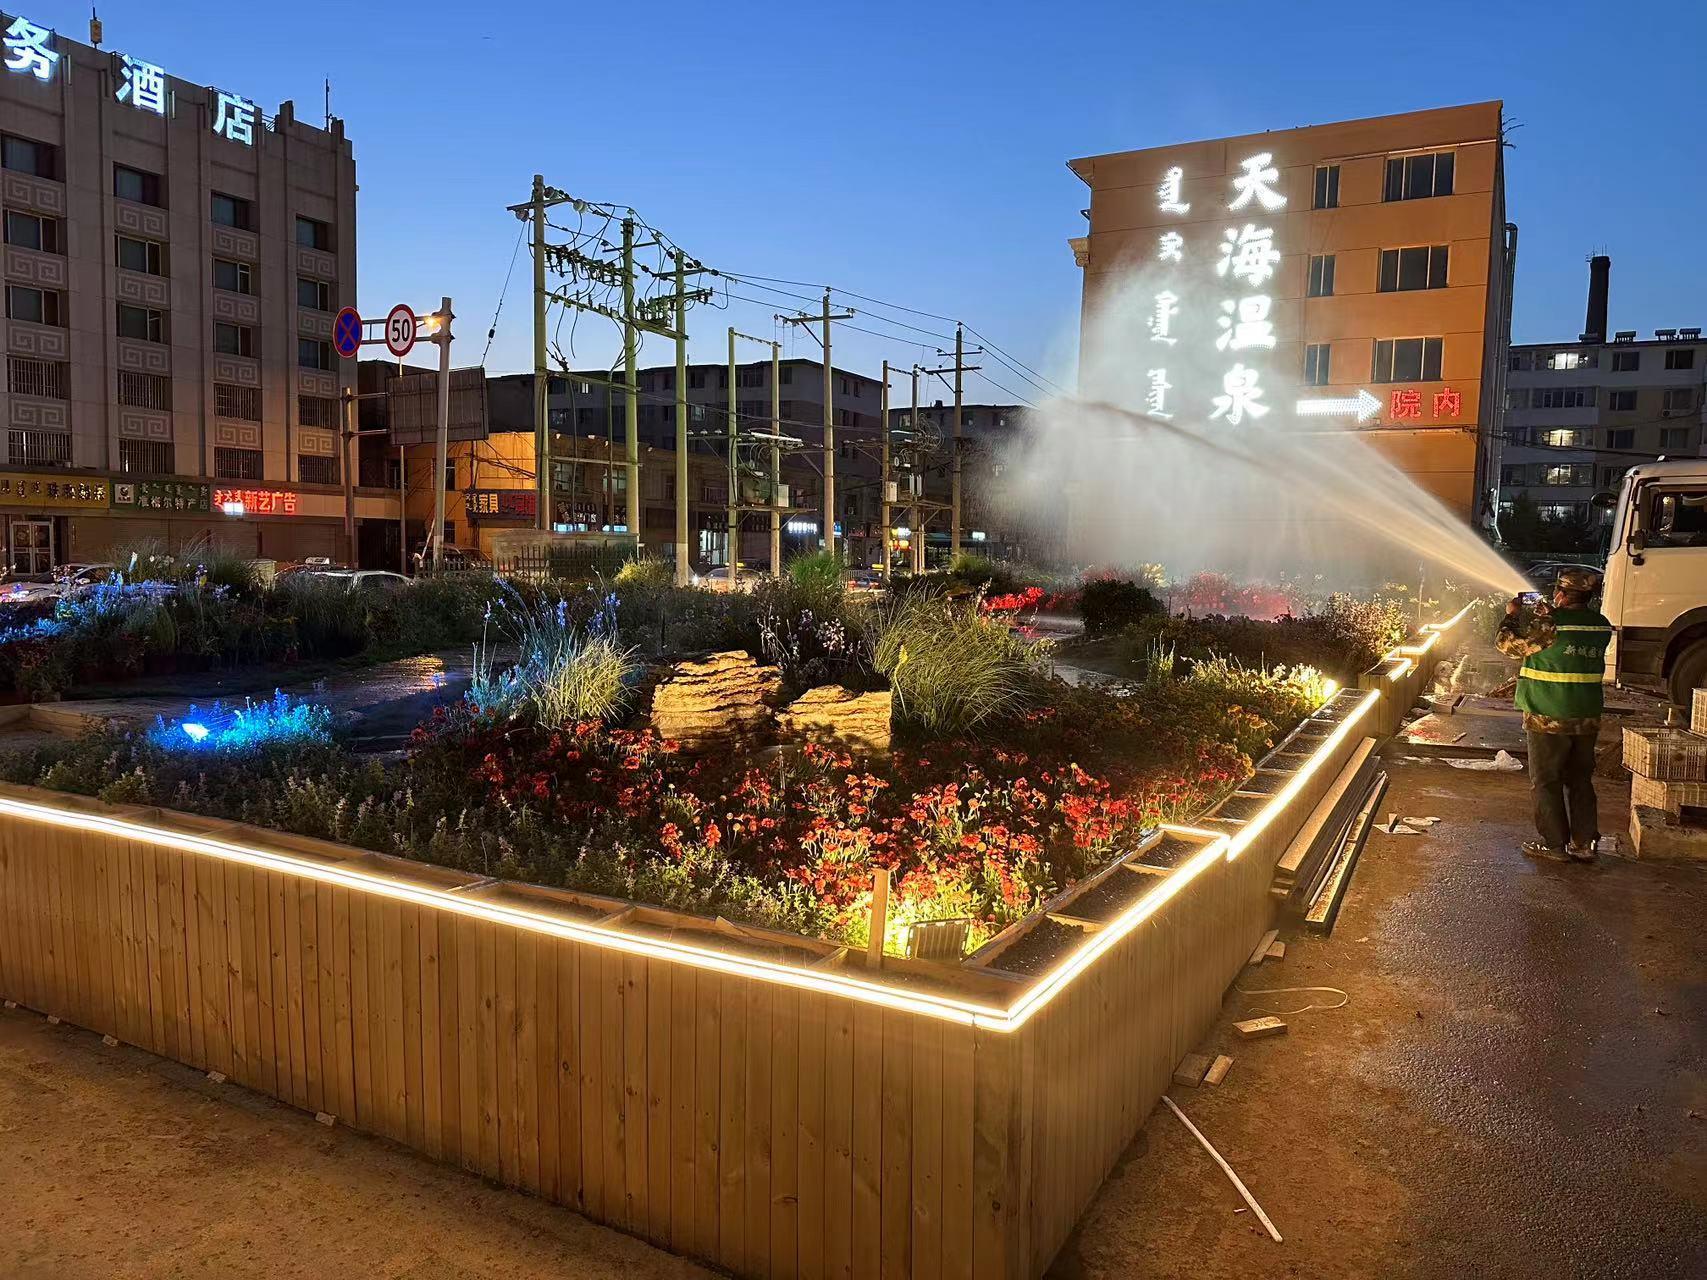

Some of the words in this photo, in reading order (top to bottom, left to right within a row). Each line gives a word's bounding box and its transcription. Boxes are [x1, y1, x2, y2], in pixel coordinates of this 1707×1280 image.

[2, 16, 255, 146] 务酒店
[1208, 152, 1288, 425] 天海温泉
[391, 318, 410, 343] 50
[1391, 387, 1461, 418] 院内
[244, 490, 296, 513] 新艺广告
